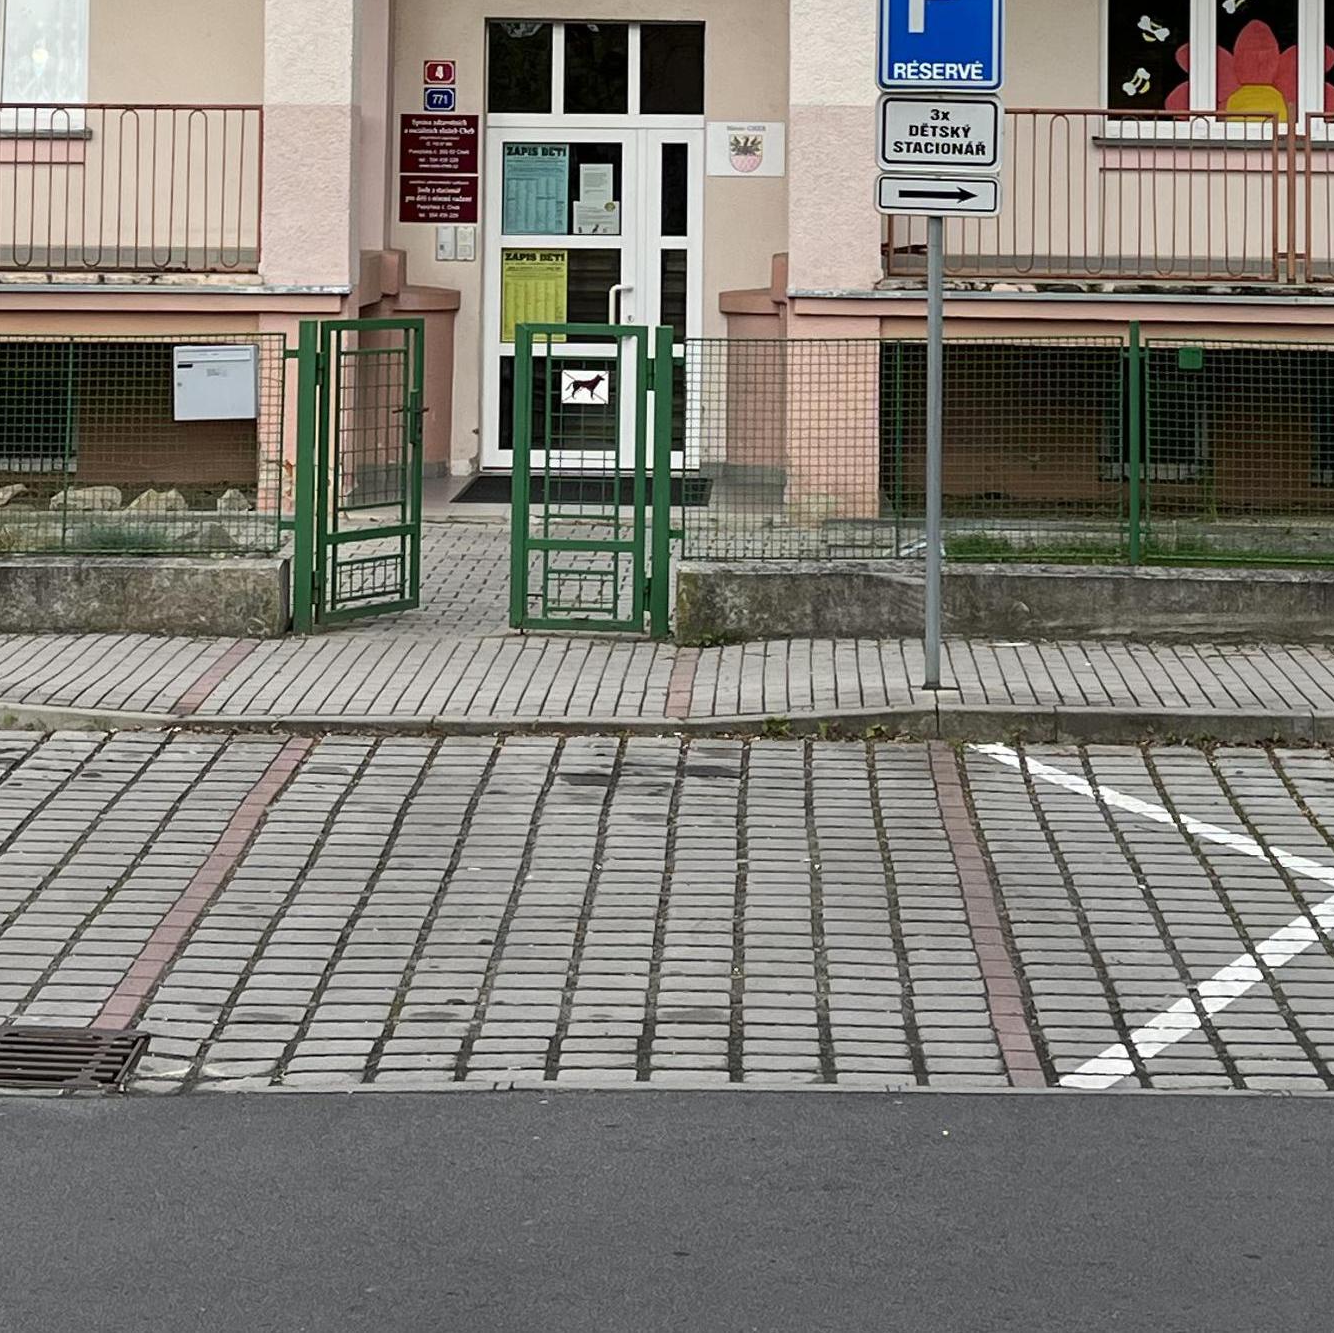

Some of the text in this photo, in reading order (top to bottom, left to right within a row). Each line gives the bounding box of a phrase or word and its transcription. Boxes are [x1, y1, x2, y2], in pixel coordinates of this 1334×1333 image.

[435, 65, 444, 79] 4
[893, 59, 984, 80] RÉSERVÉ
[432, 94, 448, 105] 771
[930, 108, 950, 121] 3x
[908, 123, 971, 138] DĚTSKÝ
[893, 140, 986, 156] STACIONÁŘ
